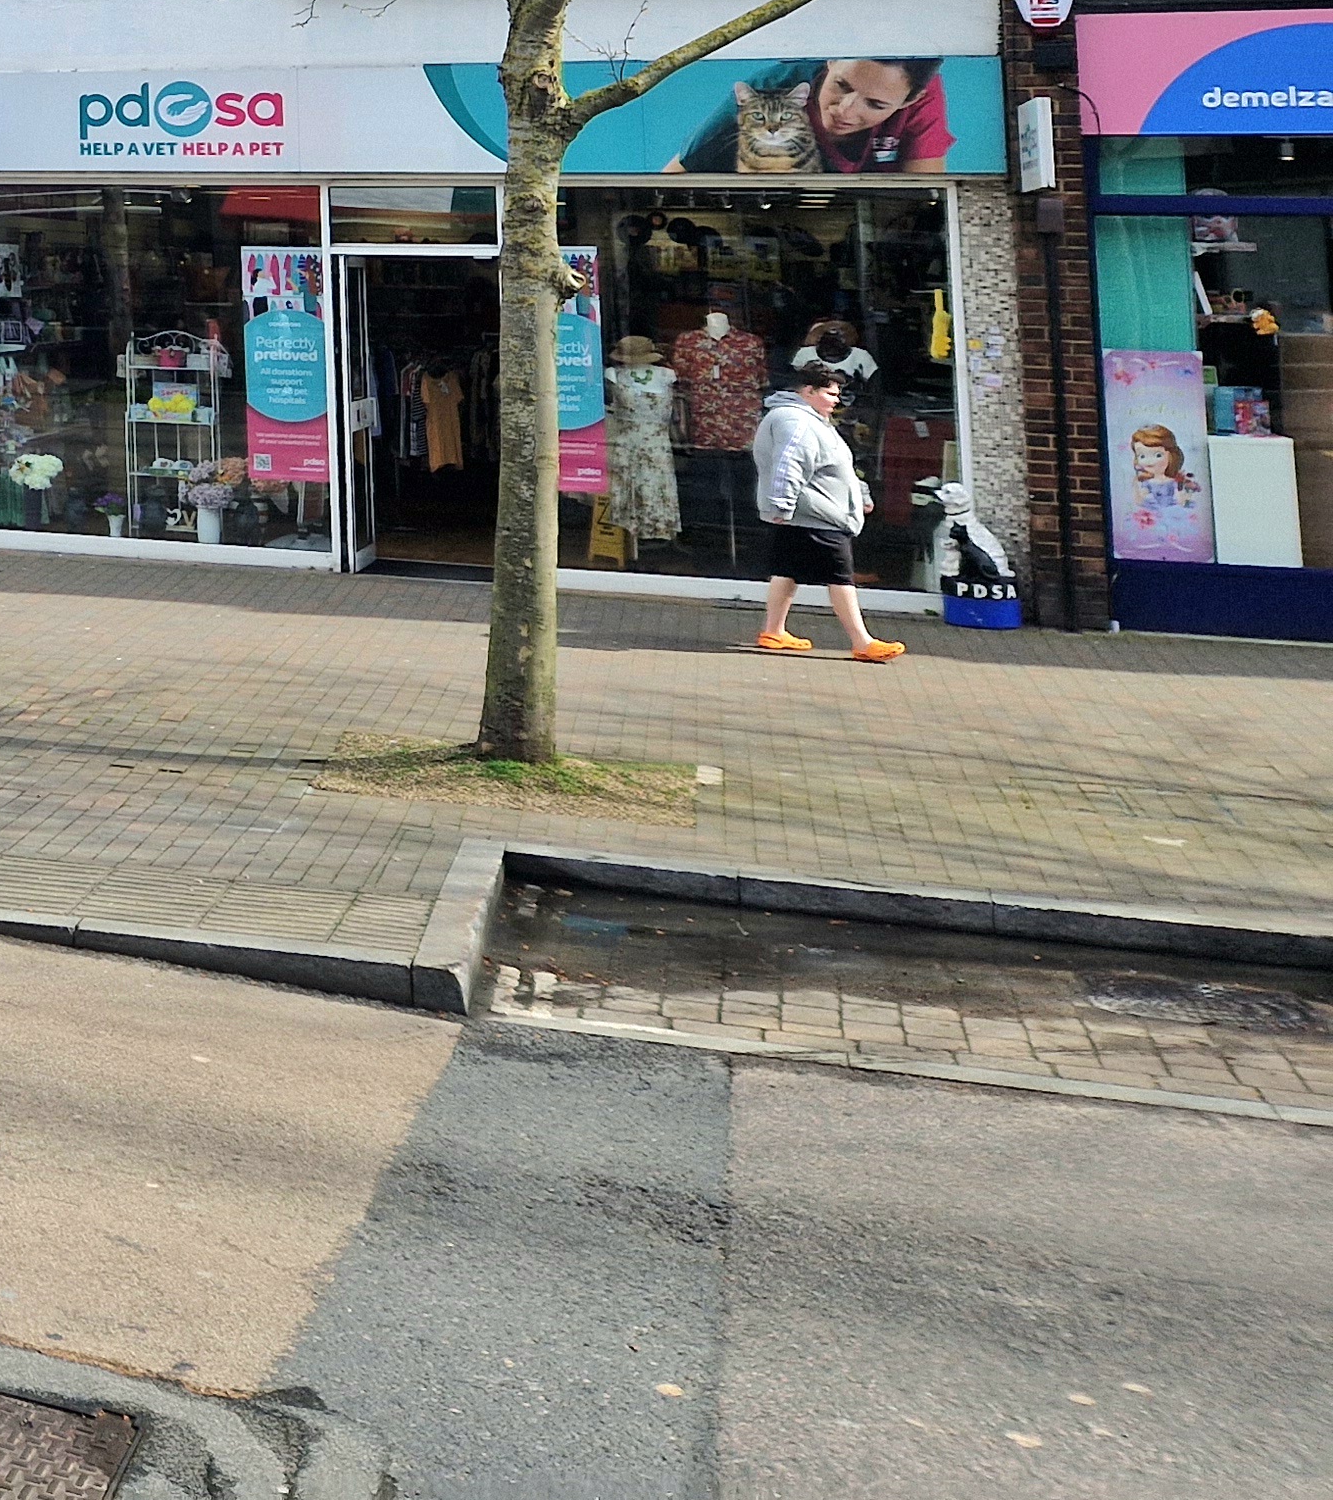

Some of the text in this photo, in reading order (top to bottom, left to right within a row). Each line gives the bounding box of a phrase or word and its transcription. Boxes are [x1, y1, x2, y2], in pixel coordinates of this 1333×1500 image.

[1202, 85, 1333, 108] demelza
[80, 142, 284, 156] HELP A VET HELP A PET
[255, 336, 315, 352] Perfectly
[254, 350, 318, 363] preloved
[271, 368, 312, 377] donations
[271, 378, 303, 387] support
[955, 581, 1017, 599] PDSA
